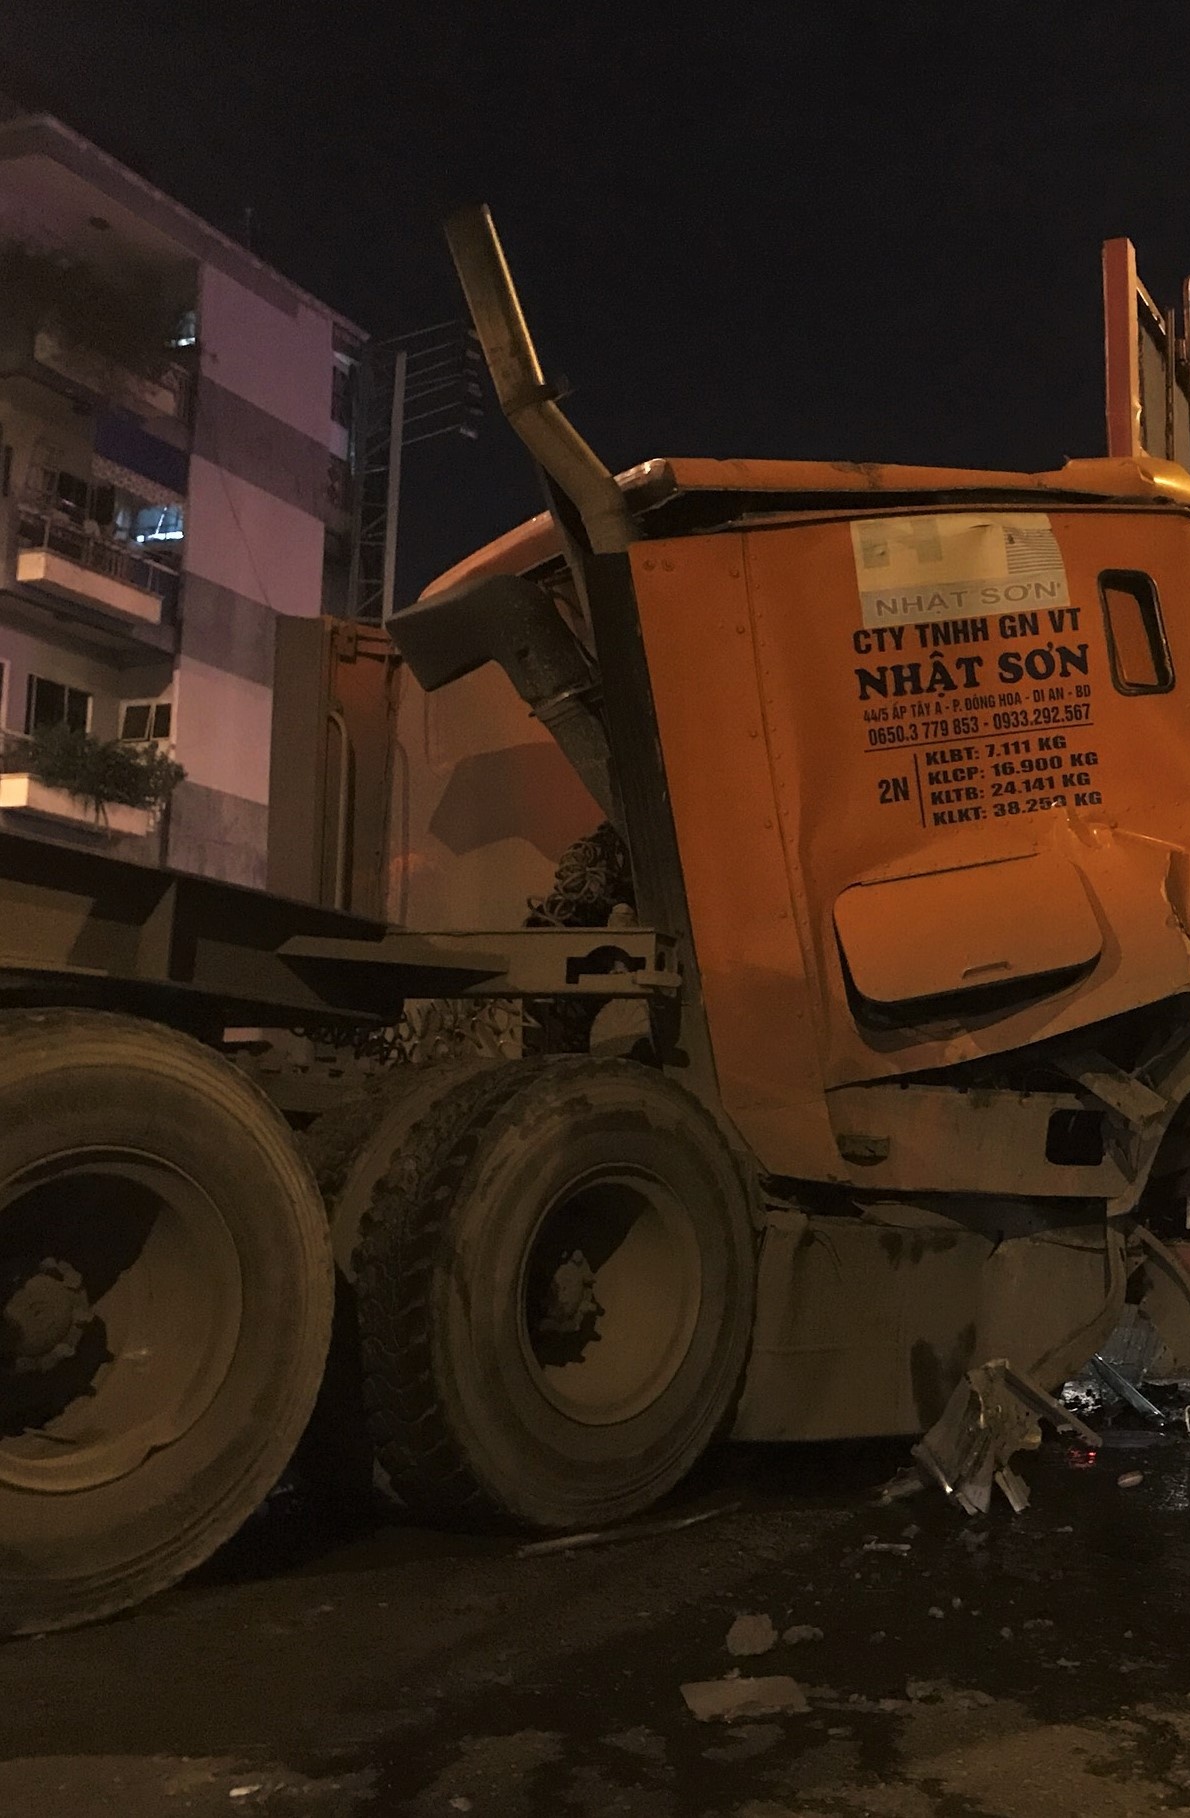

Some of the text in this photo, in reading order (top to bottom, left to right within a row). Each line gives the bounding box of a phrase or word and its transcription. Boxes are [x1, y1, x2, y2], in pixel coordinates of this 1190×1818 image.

[853, 607, 1082, 654] CTY TNHH GN VT
[854, 641, 1090, 701] NHẬT SƠN
[862, 707, 890, 724] 44/5
[952, 697, 963, 713] P.
[1048, 687, 1065, 702] AN
[868, 723, 919, 746] 0650.3
[922, 720, 948, 740] 779
[954, 716, 979, 735] 853
[993, 703, 1091, 730] 0933.292.567
[926, 735, 1067, 766] KLBT: 7.111 KG
[928, 751, 1099, 786] KLCP: 16.900 KG
[878, 776, 911, 804] 2N
[930, 772, 1092, 806] KLTB: 24.141 KG
[933, 806, 988, 827] KLKT:
[1074, 791, 1103, 808] KG
